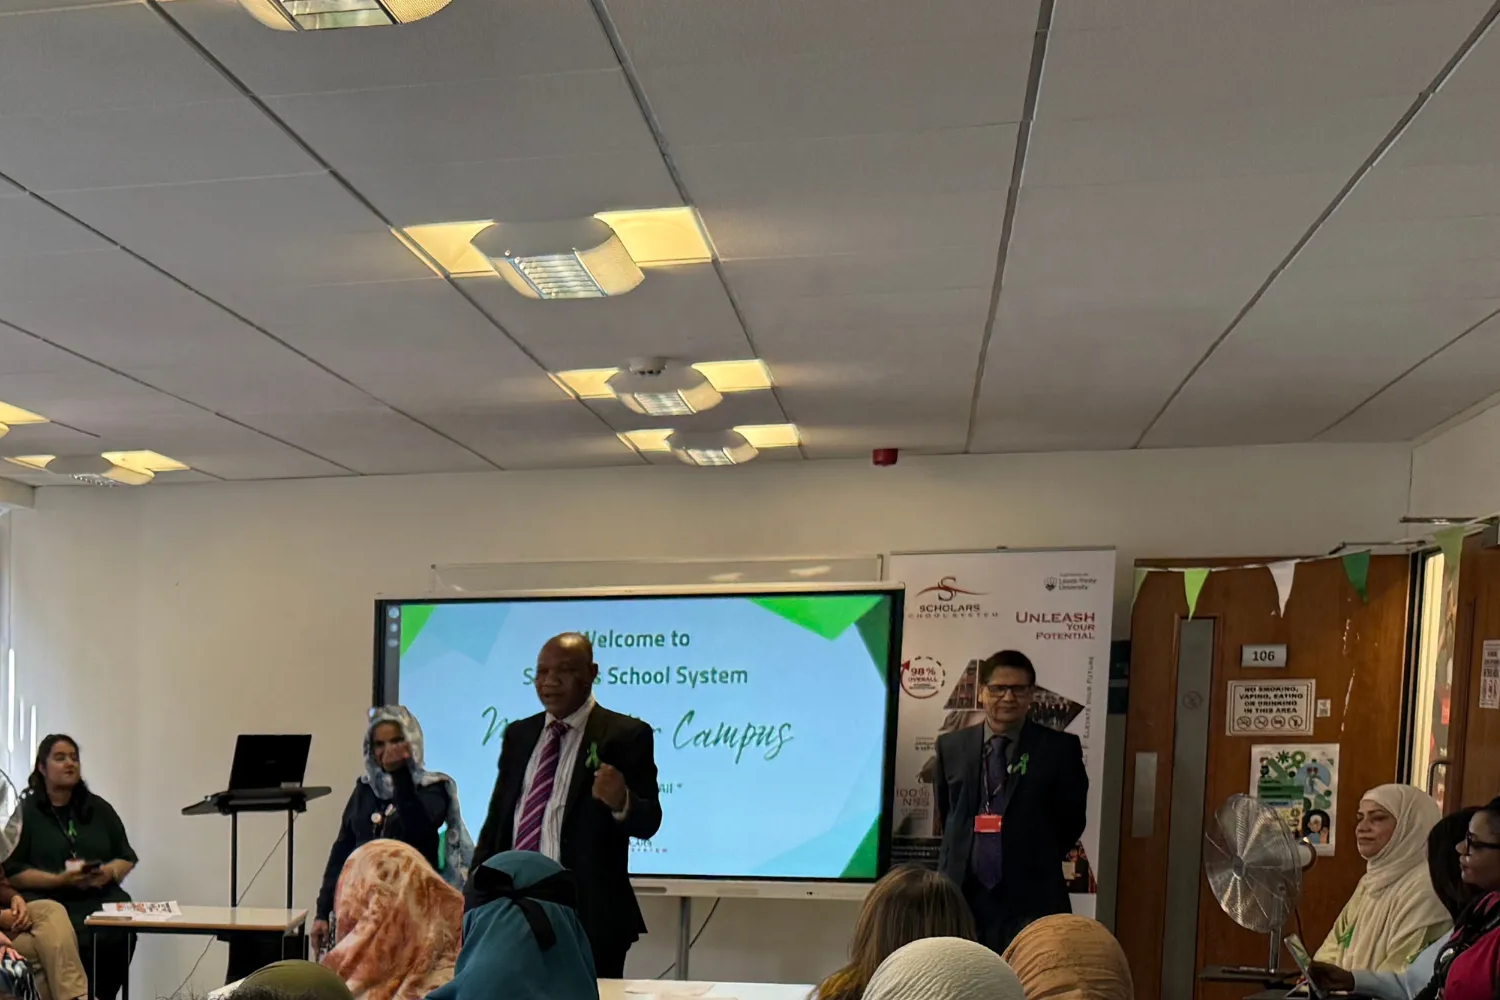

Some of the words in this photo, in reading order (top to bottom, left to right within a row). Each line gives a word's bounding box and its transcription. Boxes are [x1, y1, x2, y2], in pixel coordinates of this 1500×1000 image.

[919, 604, 980, 613] SCHOLARS
[1015, 611, 1095, 624] UNLEASH
[1066, 623, 1095, 631] YOUR
[672, 630, 690, 647] to
[1035, 632, 1095, 641] POTENTIAL
[1252, 650, 1275, 661] 106
[607, 666, 670, 685] School
[676, 666, 748, 688] System
[673, 709, 795, 764] Campus
